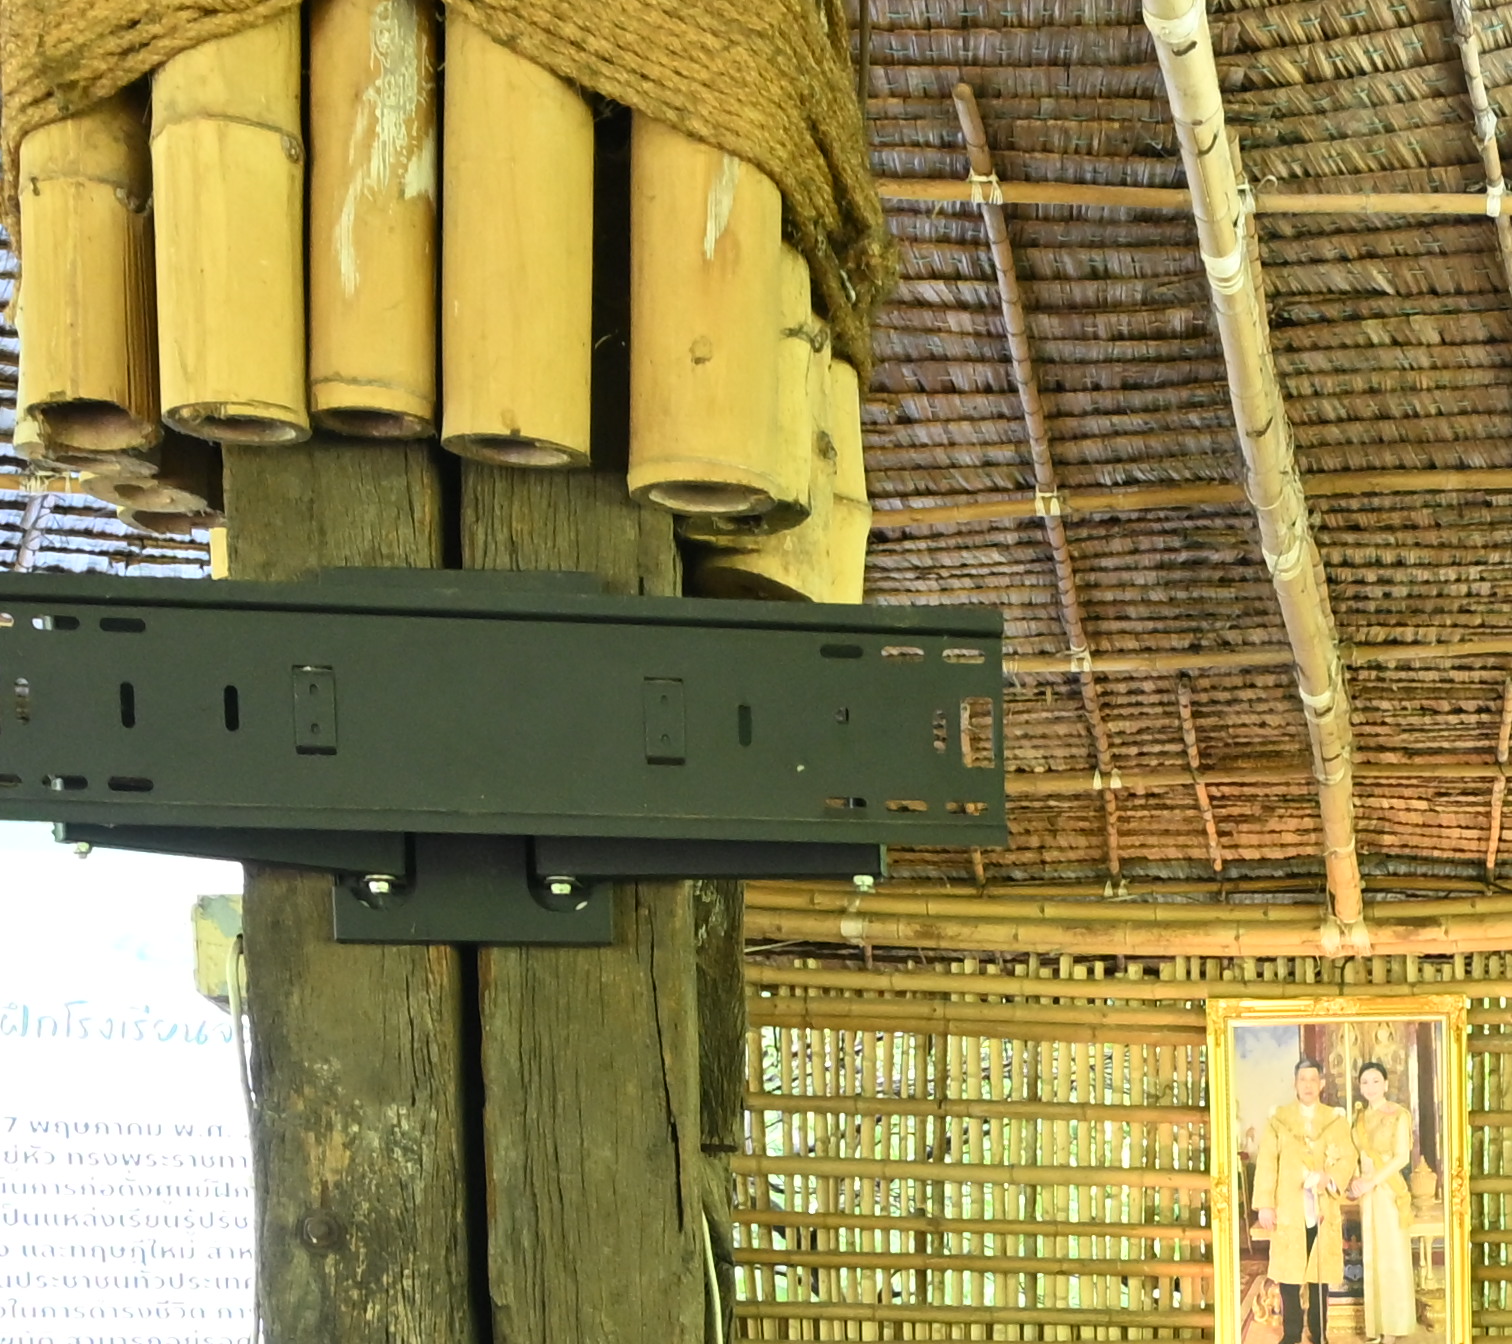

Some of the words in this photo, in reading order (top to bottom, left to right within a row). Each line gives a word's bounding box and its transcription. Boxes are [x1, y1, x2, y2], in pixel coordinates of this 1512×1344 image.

[3, 1116, 18, 1133] 7
[66, 1148, 248, 1170] ทรงพระราชทา
